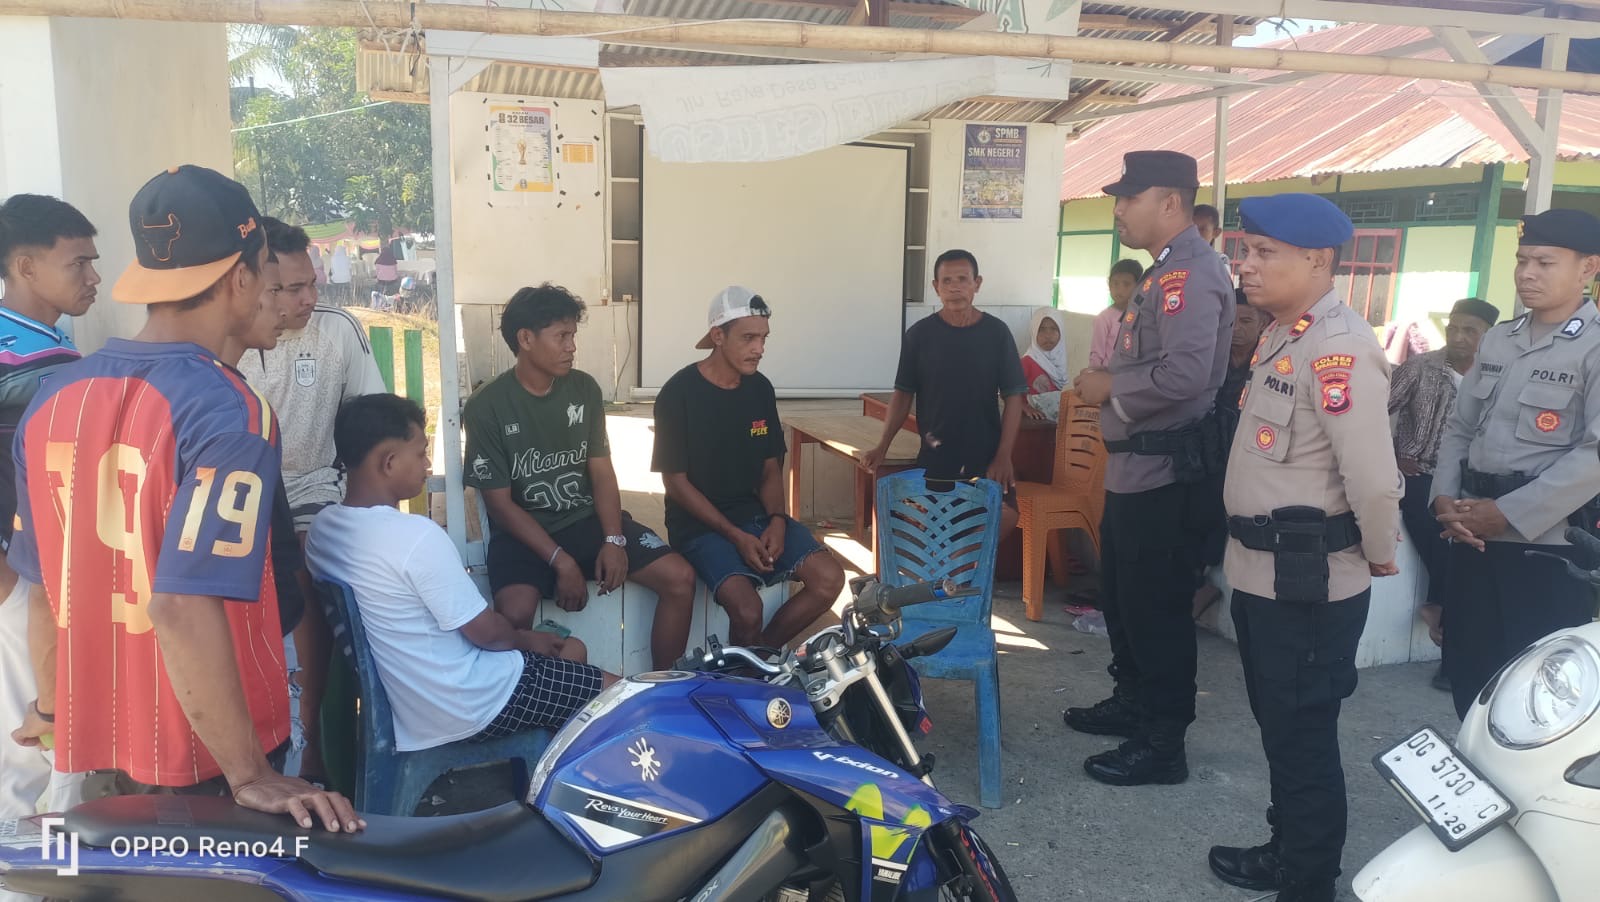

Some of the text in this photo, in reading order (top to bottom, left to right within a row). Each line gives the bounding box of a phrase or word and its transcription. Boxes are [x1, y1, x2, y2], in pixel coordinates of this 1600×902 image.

[507, 115, 518, 123] 32
[519, 116, 545, 124] BESAR
[995, 128, 1019, 138] SPMB
[968, 147, 1020, 158] SMK NEGERI 2
[1264, 375, 1294, 397] POLRI
[1530, 369, 1574, 385] POLRI
[511, 440, 588, 480] Miami
[178, 467, 263, 558] 19
[45, 442, 154, 635] 19
[1407, 733, 1499, 820] DG 5730 C
[584, 798, 669, 824] Revs Your Heart
